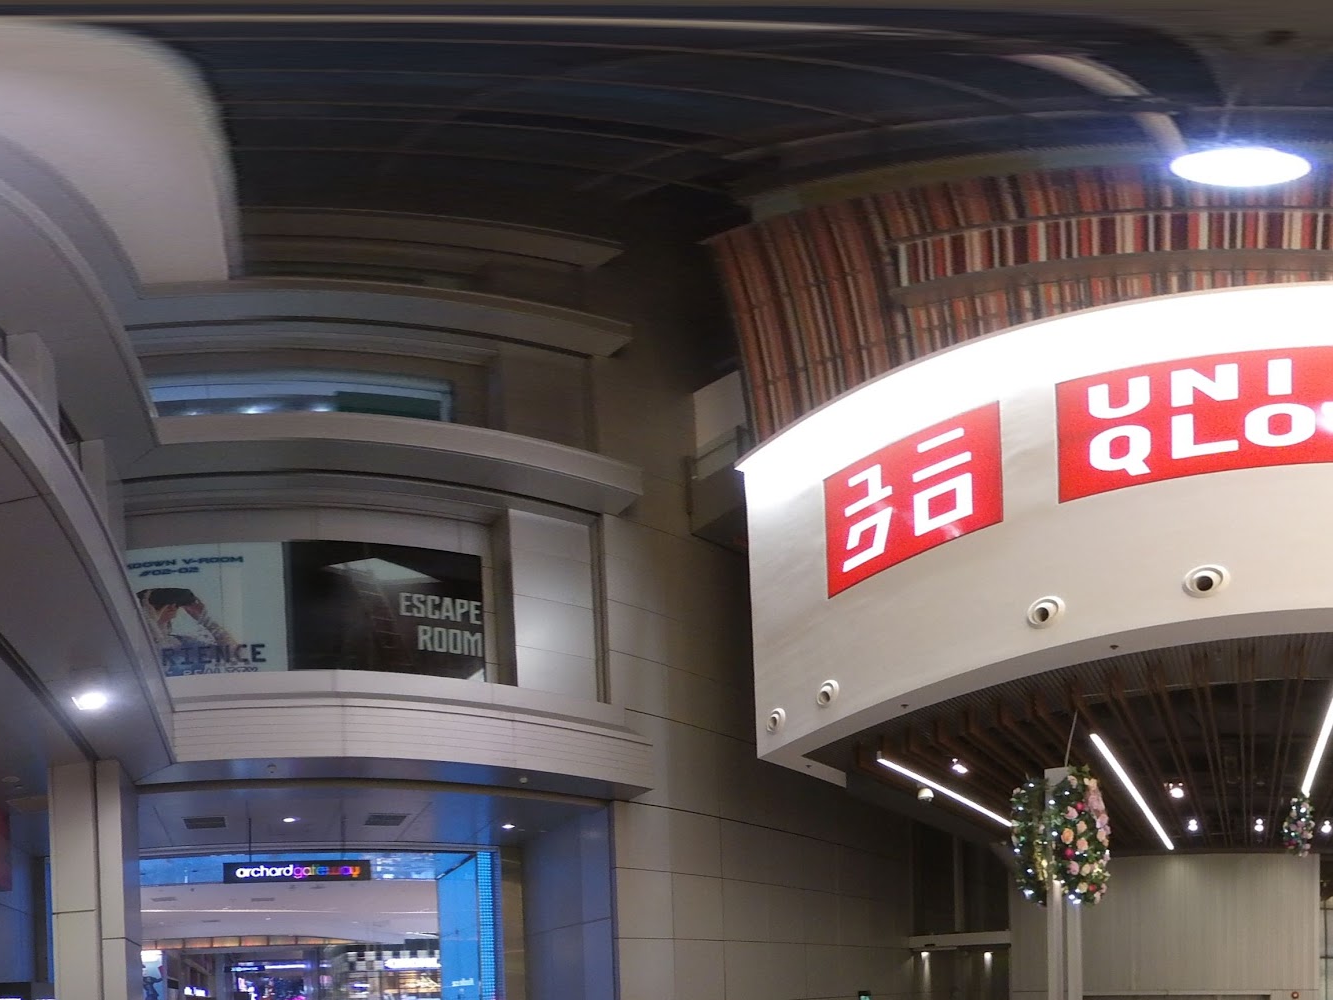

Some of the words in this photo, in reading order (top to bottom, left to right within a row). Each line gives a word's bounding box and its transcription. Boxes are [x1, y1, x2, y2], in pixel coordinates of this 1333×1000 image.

[1087, 358, 1293, 419] UNI
[1089, 402, 1316, 476] QLO
[398, 592, 482, 625] ESCAPE
[161, 643, 267, 667] RIENCE
[417, 625, 483, 657] ROOM
